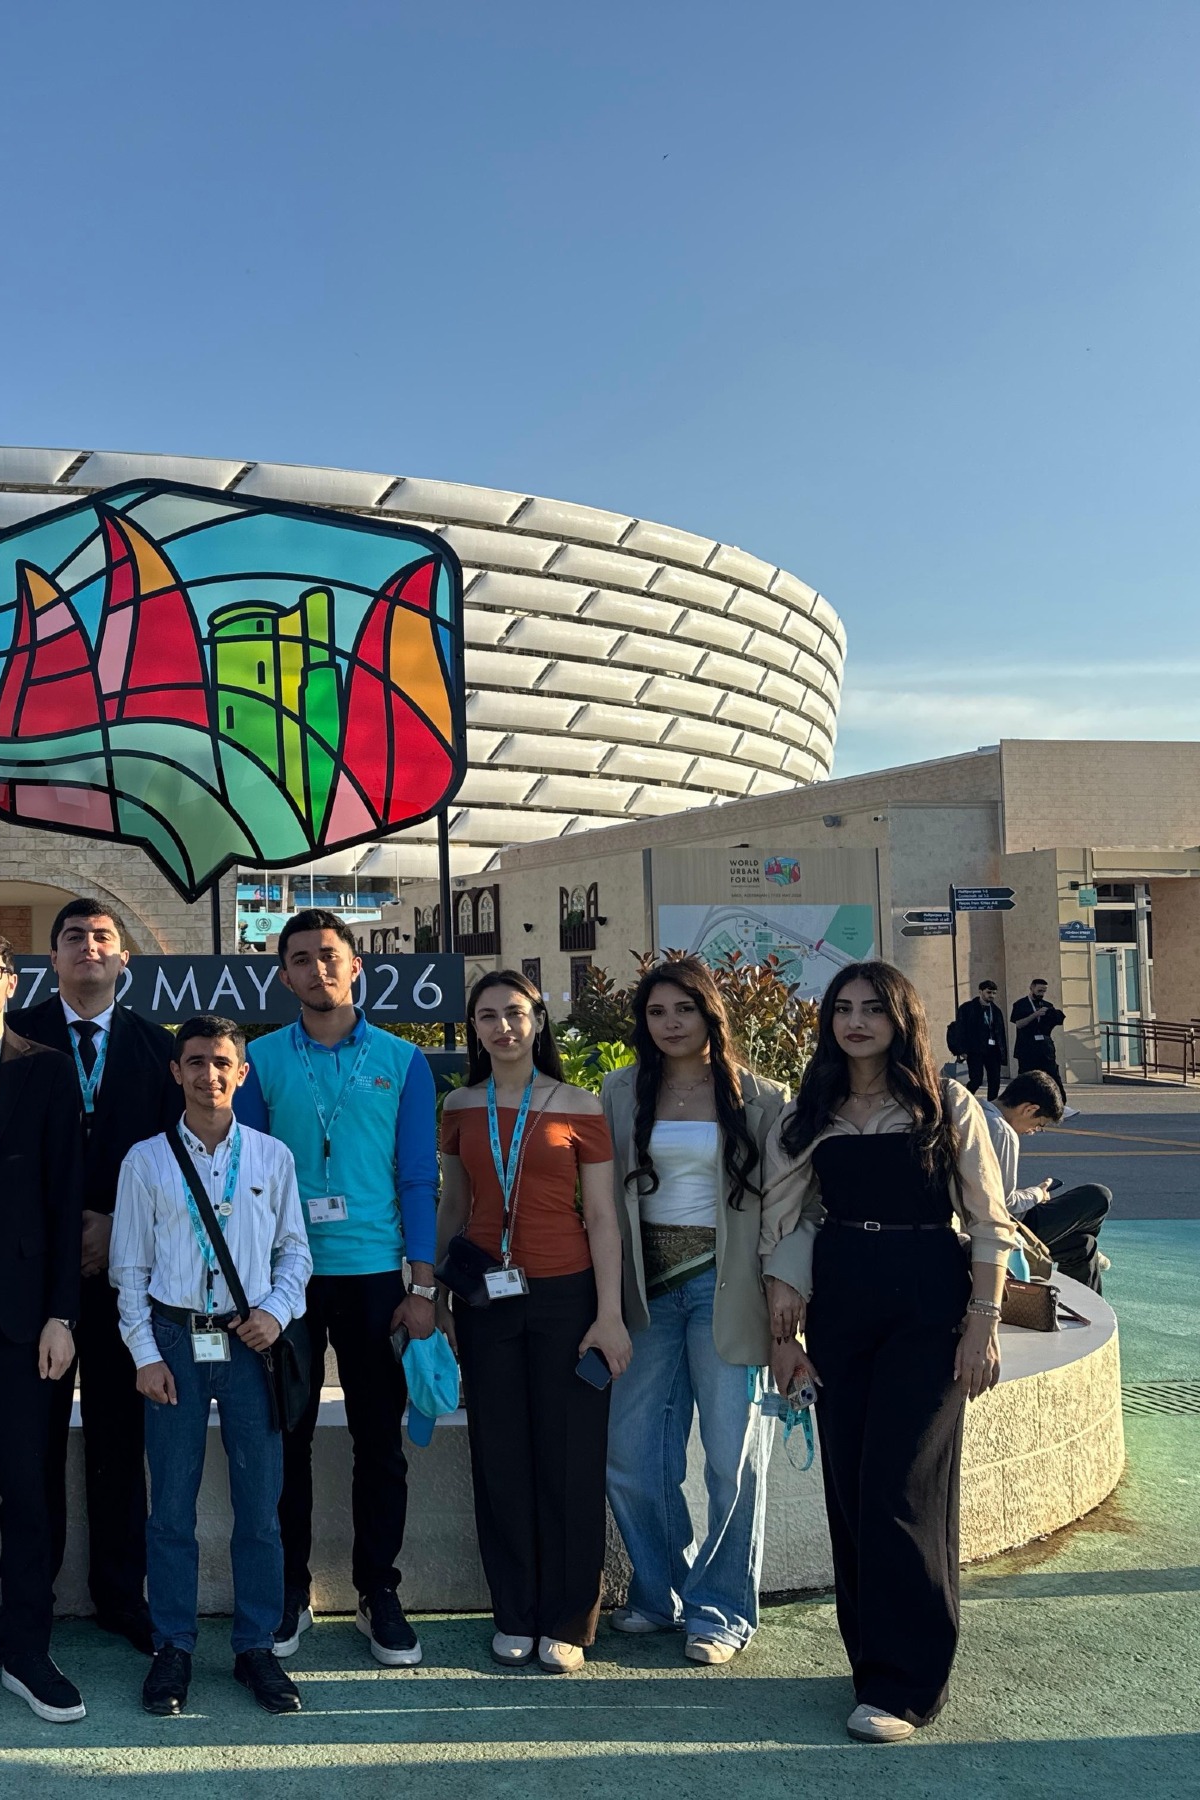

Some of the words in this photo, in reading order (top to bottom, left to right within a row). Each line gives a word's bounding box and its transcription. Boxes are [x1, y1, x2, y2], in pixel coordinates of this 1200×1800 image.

[729, 859, 759, 867] WORLD
[339, 893, 354, 907] 10
[151, 963, 280, 1012] MAY
[353, 963, 443, 1011] 26
